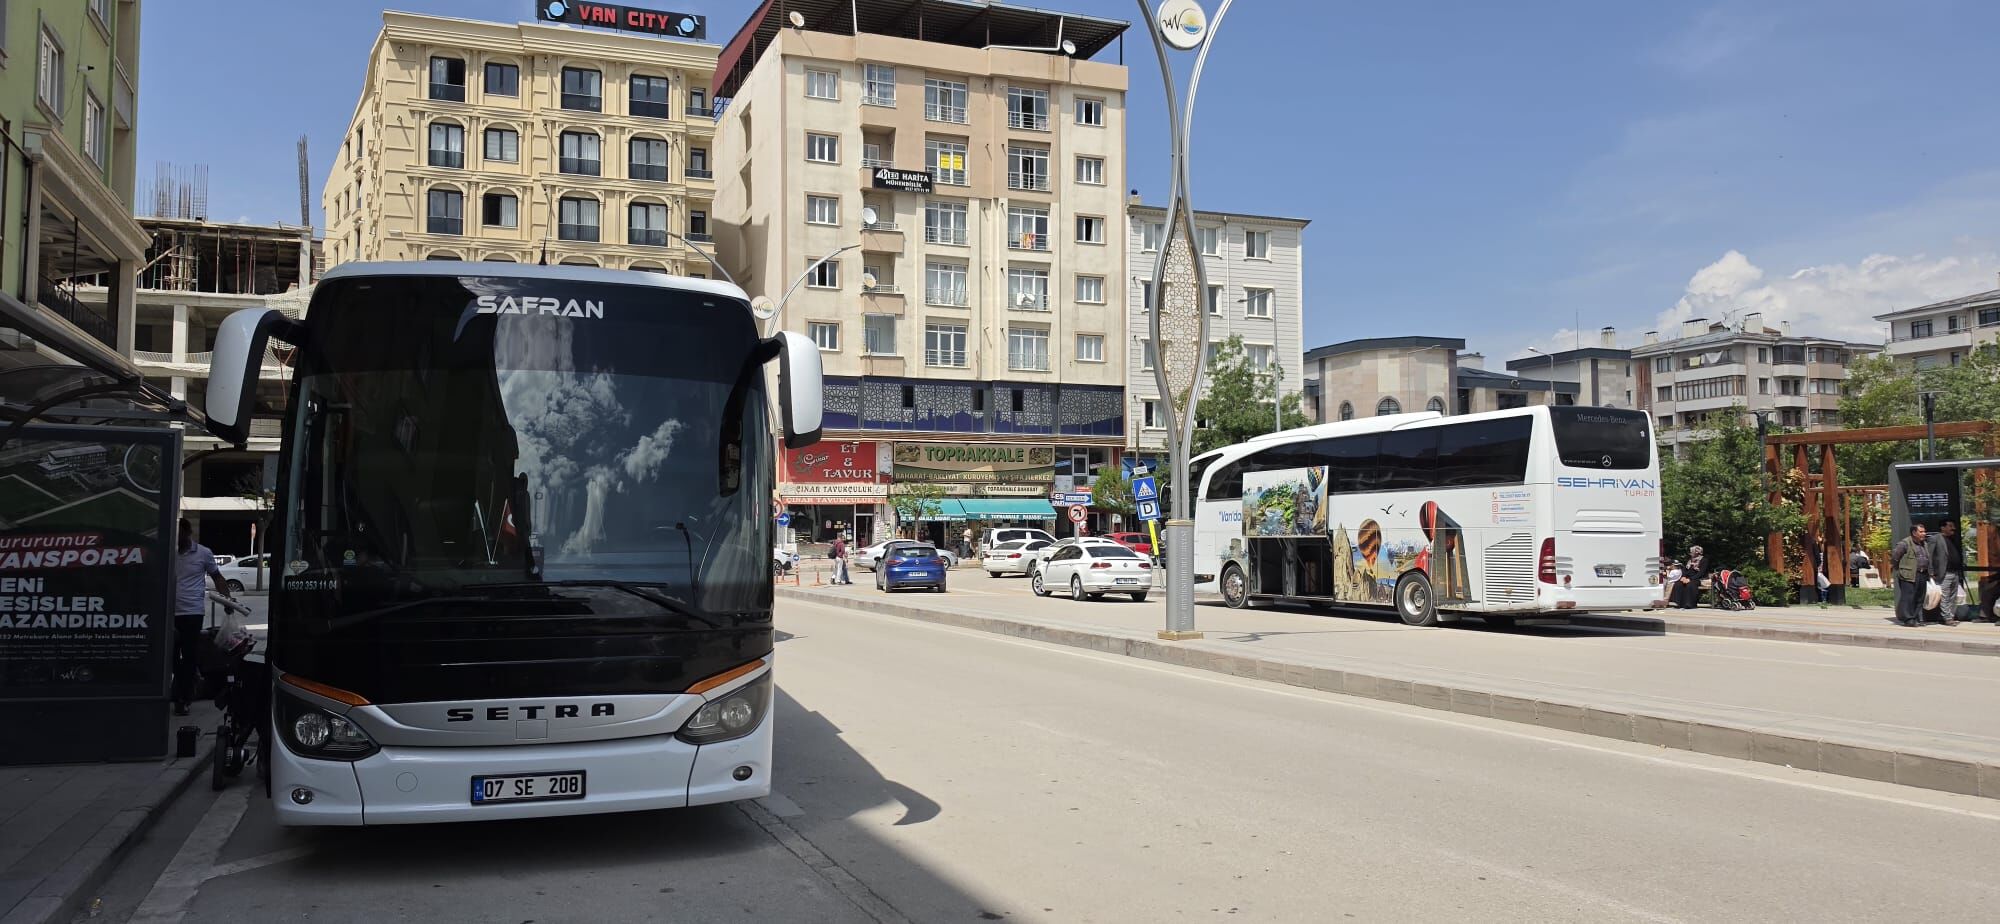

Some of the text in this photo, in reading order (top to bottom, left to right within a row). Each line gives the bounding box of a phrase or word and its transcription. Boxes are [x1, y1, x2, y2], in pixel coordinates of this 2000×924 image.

[579, 5, 670, 29] VAN CITY
[476, 295, 604, 319] SAFRAN
[840, 444, 859, 454] ET
[925, 446, 1025, 463] TOPRAKKALE
[843, 457, 853, 467] &
[823, 469, 872, 479] TAVUK
[1143, 503, 1153, 515] D
[0, 535, 98, 549] ururumuz
[287, 581, 304, 590] 0532
[305, 581, 318, 590] 353
[319, 580, 327, 590] 11
[0, 614, 149, 628] AZANDIRDIK
[446, 702, 615, 722] SETRA
[484, 780, 505, 798] 07
[514, 778, 534, 796] SE
[549, 776, 579, 794] 208
